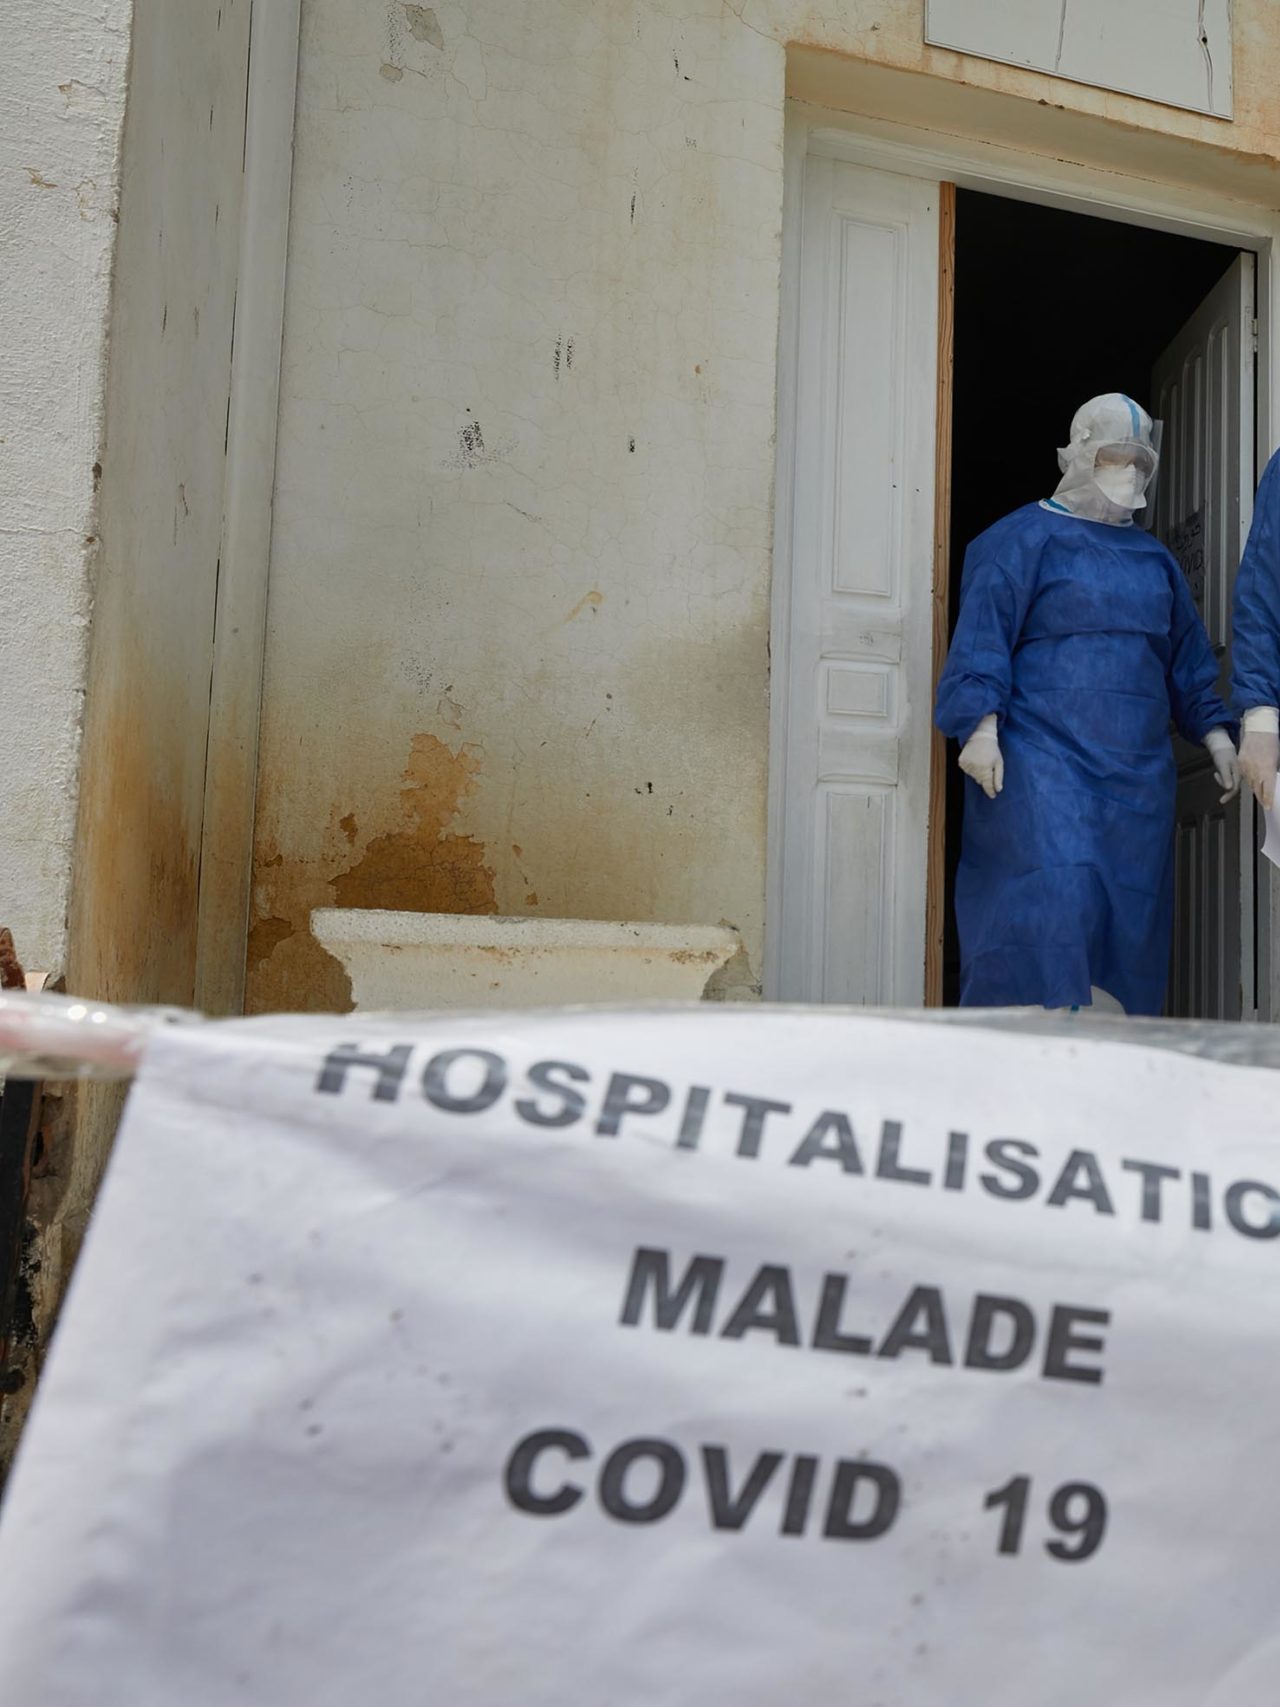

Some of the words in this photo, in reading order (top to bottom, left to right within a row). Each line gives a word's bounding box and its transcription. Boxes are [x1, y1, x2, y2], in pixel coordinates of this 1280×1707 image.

[619, 1246, 1111, 1385] MALADE
[504, 1427, 902, 1543] COVID
[981, 1472, 1109, 1563] 19
